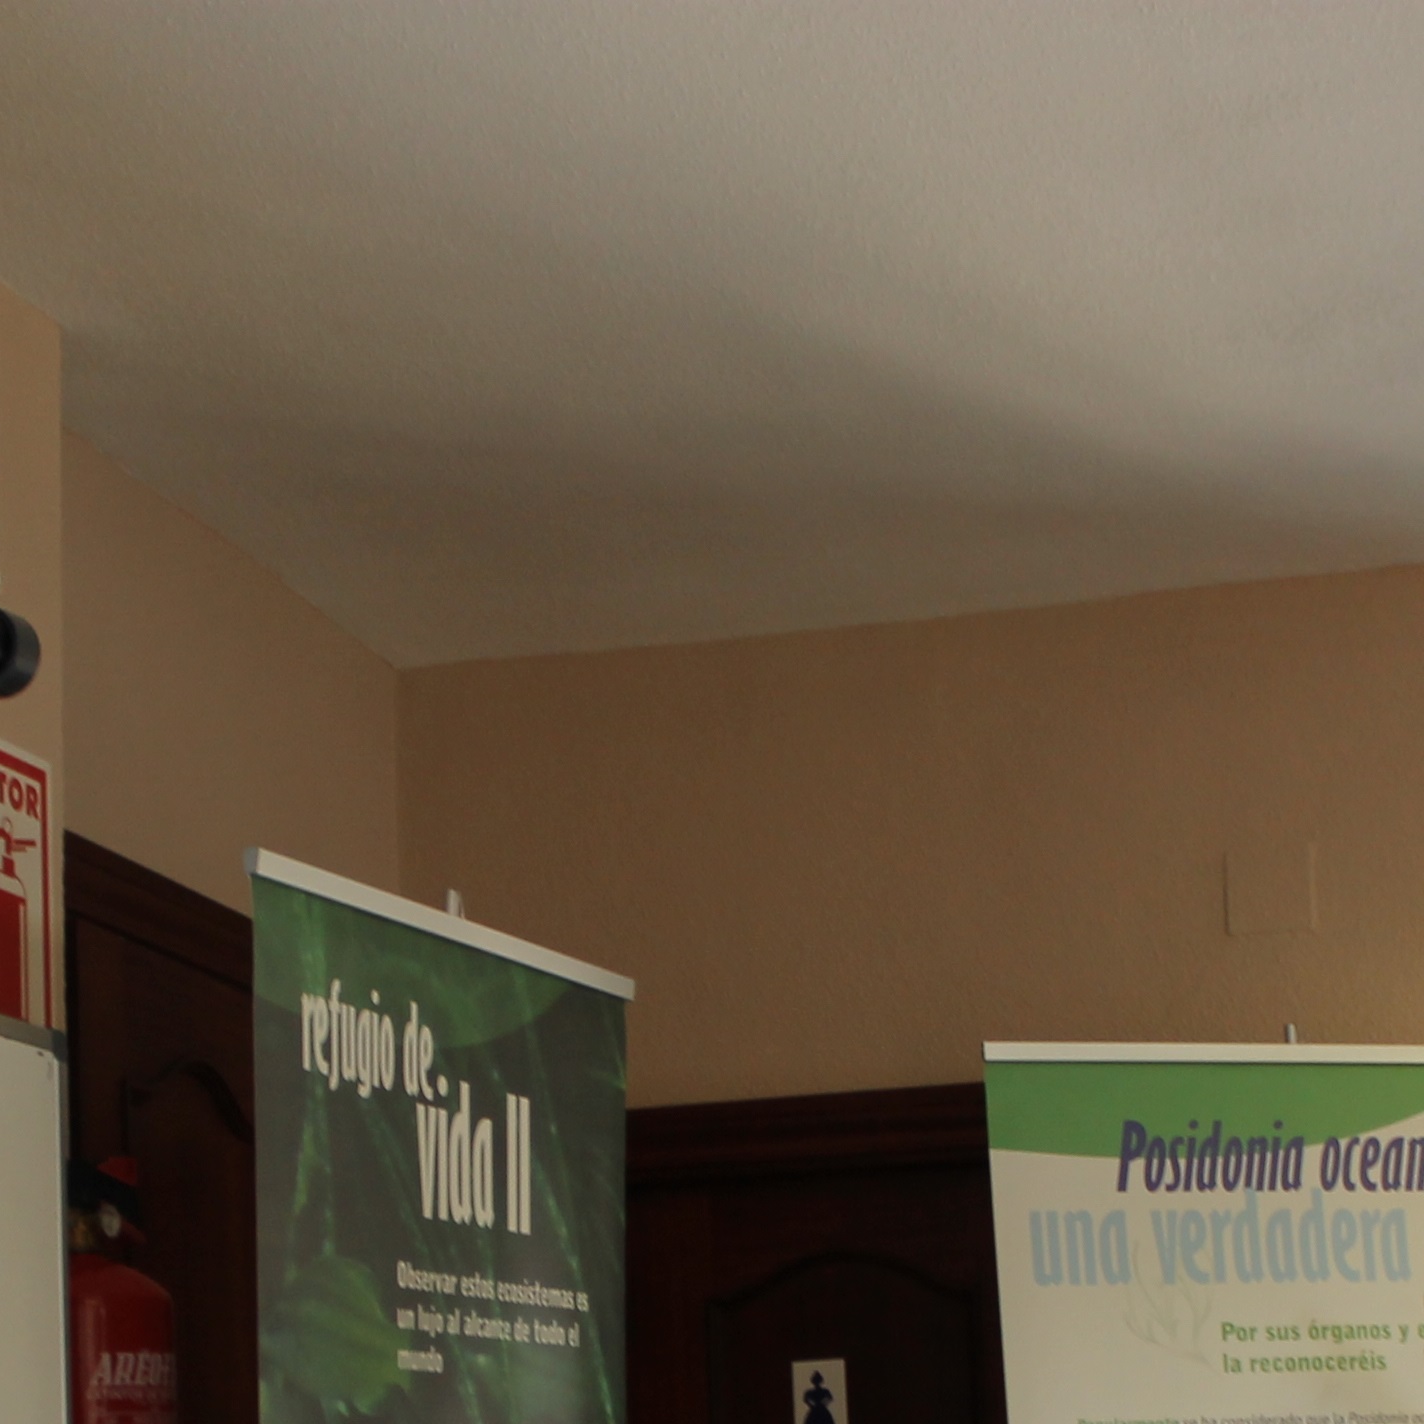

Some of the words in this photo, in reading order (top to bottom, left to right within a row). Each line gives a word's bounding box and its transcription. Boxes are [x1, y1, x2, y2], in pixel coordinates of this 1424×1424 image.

[300, 978, 395, 1099] refugio
[402, 1001, 435, 1101] de
[416, 1073, 495, 1230] vida
[505, 1092, 532, 1236] II
[1116, 1118, 1306, 1193] Posidonia
[1028, 1206, 1132, 1287] una
[1149, 1187, 1413, 1287] verdadera
[1219, 1322, 1260, 1343] Por
[1265, 1324, 1302, 1343] sus
[1307, 1319, 1392, 1346] órganos
[1397, 1323, 1410, 1345] y
[1222, 1352, 1243, 1374] la
[1249, 1349, 1388, 1374] reconoceréis
